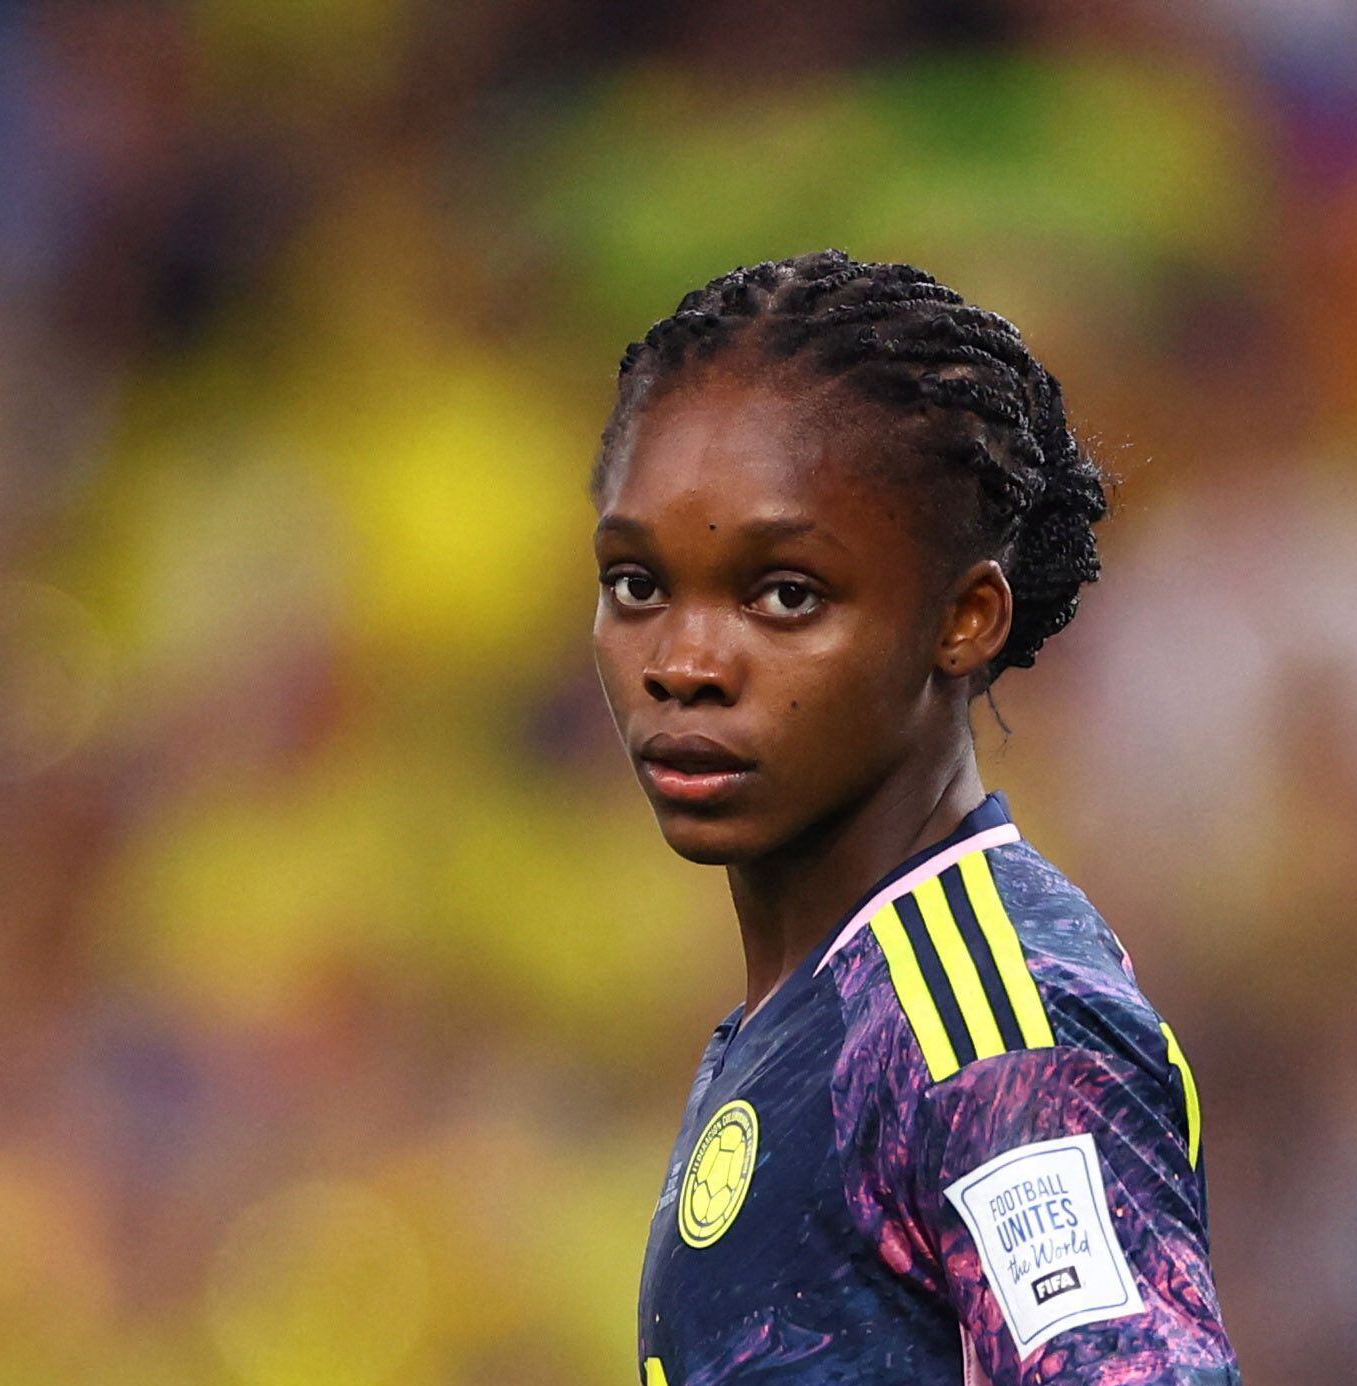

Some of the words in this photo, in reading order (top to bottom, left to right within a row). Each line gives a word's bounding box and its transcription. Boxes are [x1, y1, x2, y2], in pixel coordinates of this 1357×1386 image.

[989, 1174, 1069, 1222] FOOTBALL
[996, 1198, 1079, 1253] UNITES
[1007, 1256, 1032, 1285] the
[1031, 1229, 1092, 1270] World
[1035, 1271, 1075, 1301] FIFA
